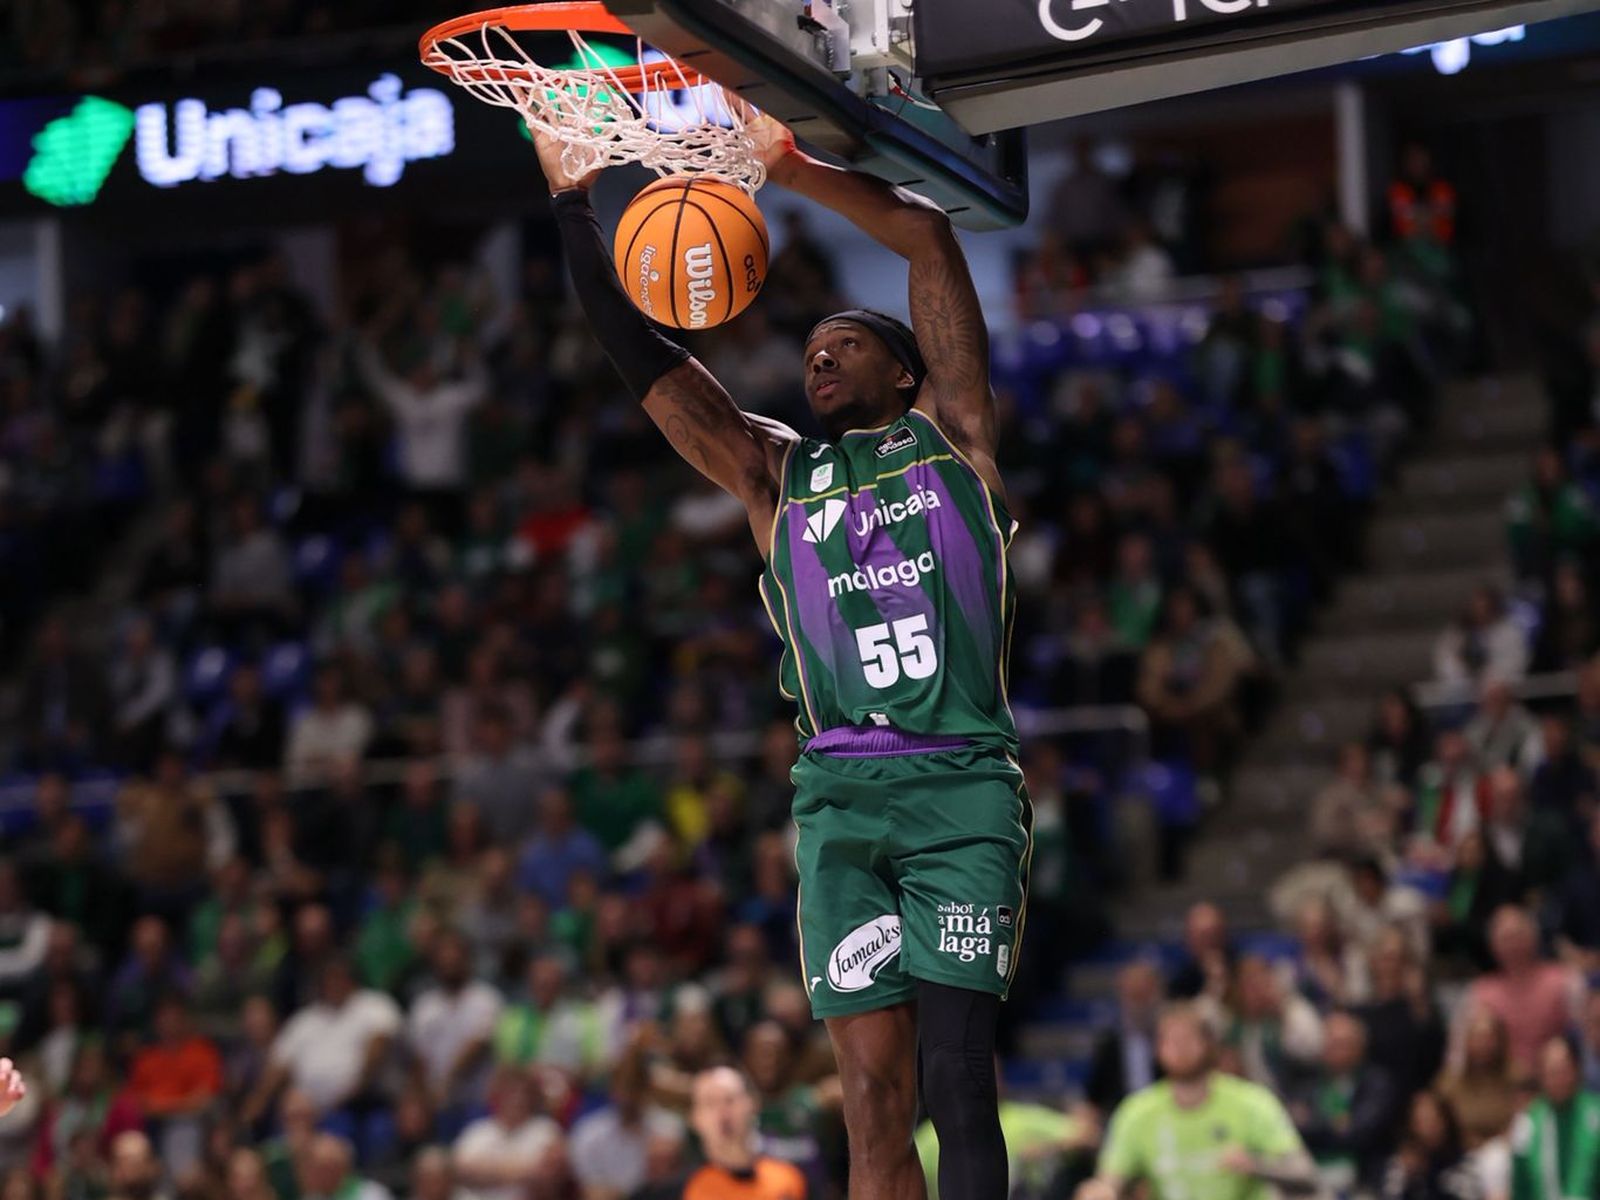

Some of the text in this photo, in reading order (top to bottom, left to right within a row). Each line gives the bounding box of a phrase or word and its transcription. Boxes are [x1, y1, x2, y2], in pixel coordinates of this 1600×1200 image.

[135, 73, 454, 187] Unicaja
[685, 243, 716, 328] Wilson
[855, 613, 937, 689] 55
[937, 902, 975, 914] sabor
[946, 907, 992, 934] má
[937, 928, 991, 962] laga
